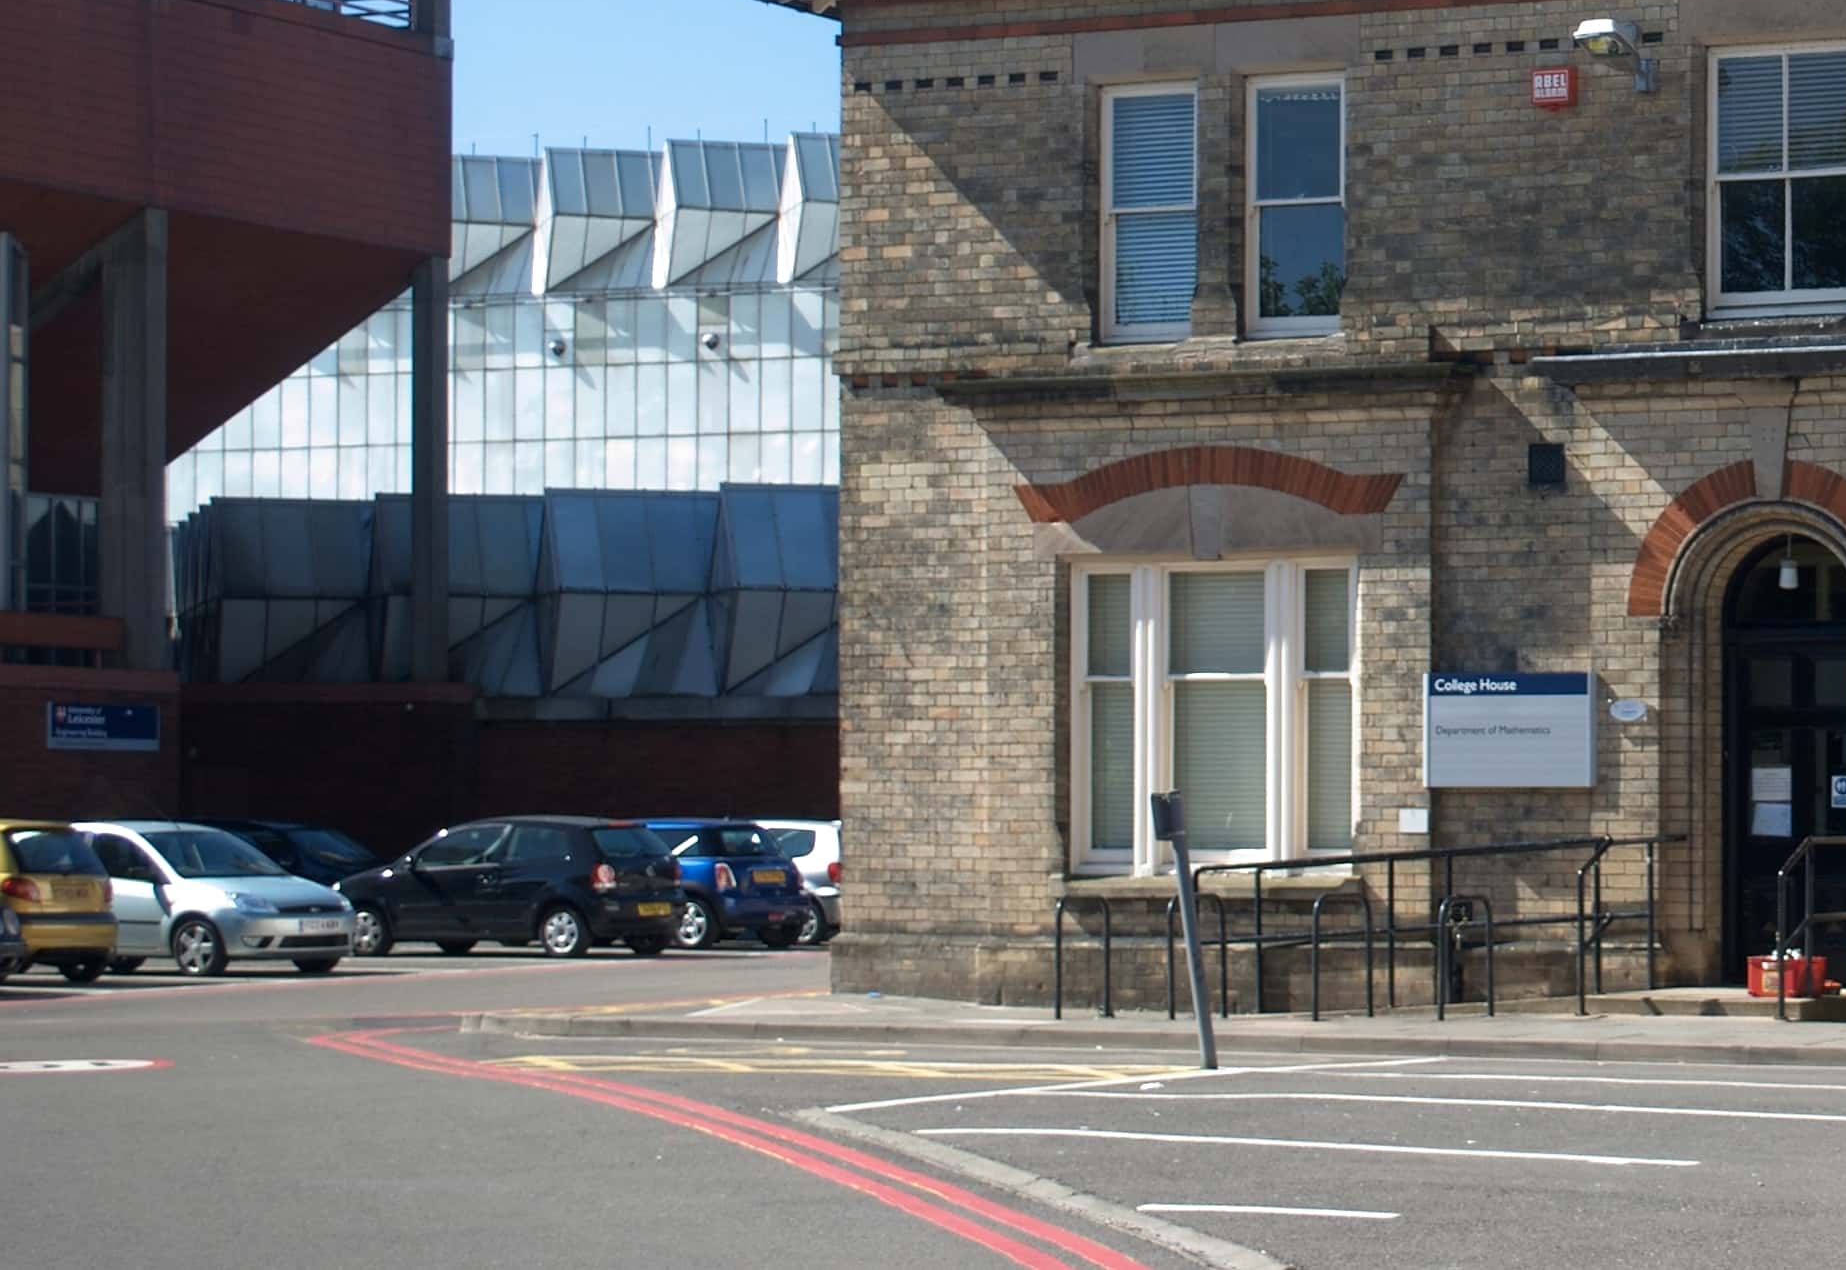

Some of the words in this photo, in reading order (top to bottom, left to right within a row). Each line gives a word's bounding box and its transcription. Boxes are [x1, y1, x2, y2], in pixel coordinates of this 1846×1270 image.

[1434, 678, 1478, 694] College
[1479, 678, 1517, 692] House
[67, 714, 105, 724] Leicester
[1435, 725, 1486, 737] Department
[1488, 725, 1497, 735] of
[1499, 725, 1551, 735] Mathematics
